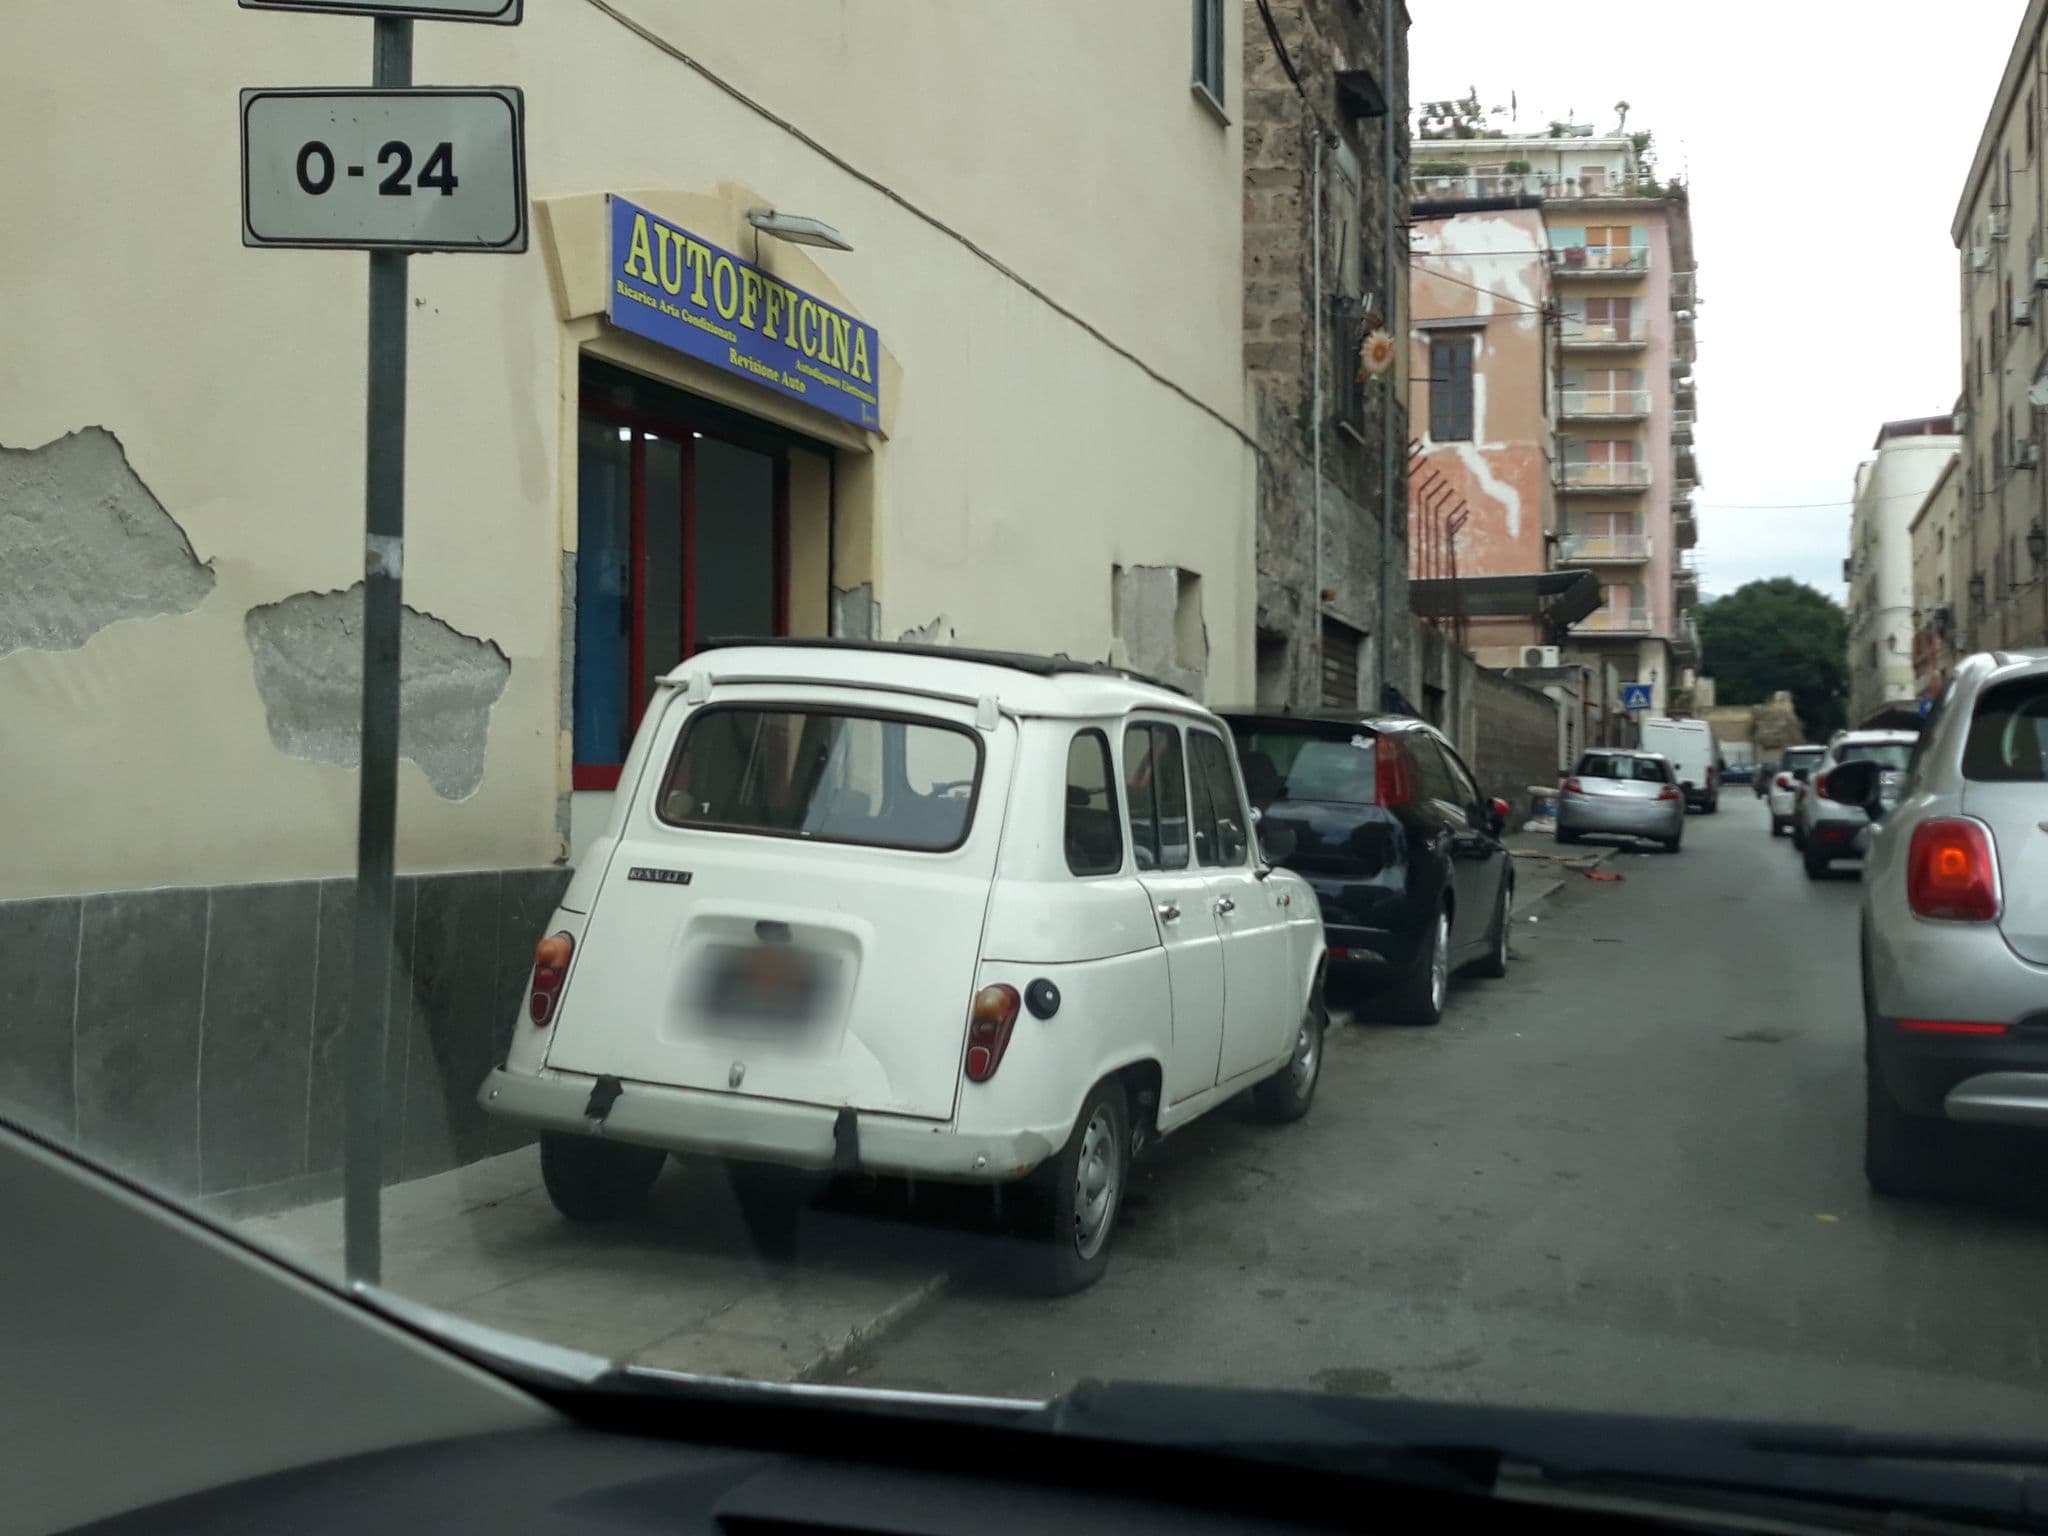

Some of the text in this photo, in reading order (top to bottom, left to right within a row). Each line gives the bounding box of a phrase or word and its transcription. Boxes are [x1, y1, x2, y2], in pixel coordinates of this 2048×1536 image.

[616, 279, 657, 308] Ricarica
[659, 298, 680, 318] Aria
[623, 211, 873, 386] AUTOFFICINA
[729, 346, 779, 383] Revisione
[781, 371, 807, 394] Auto
